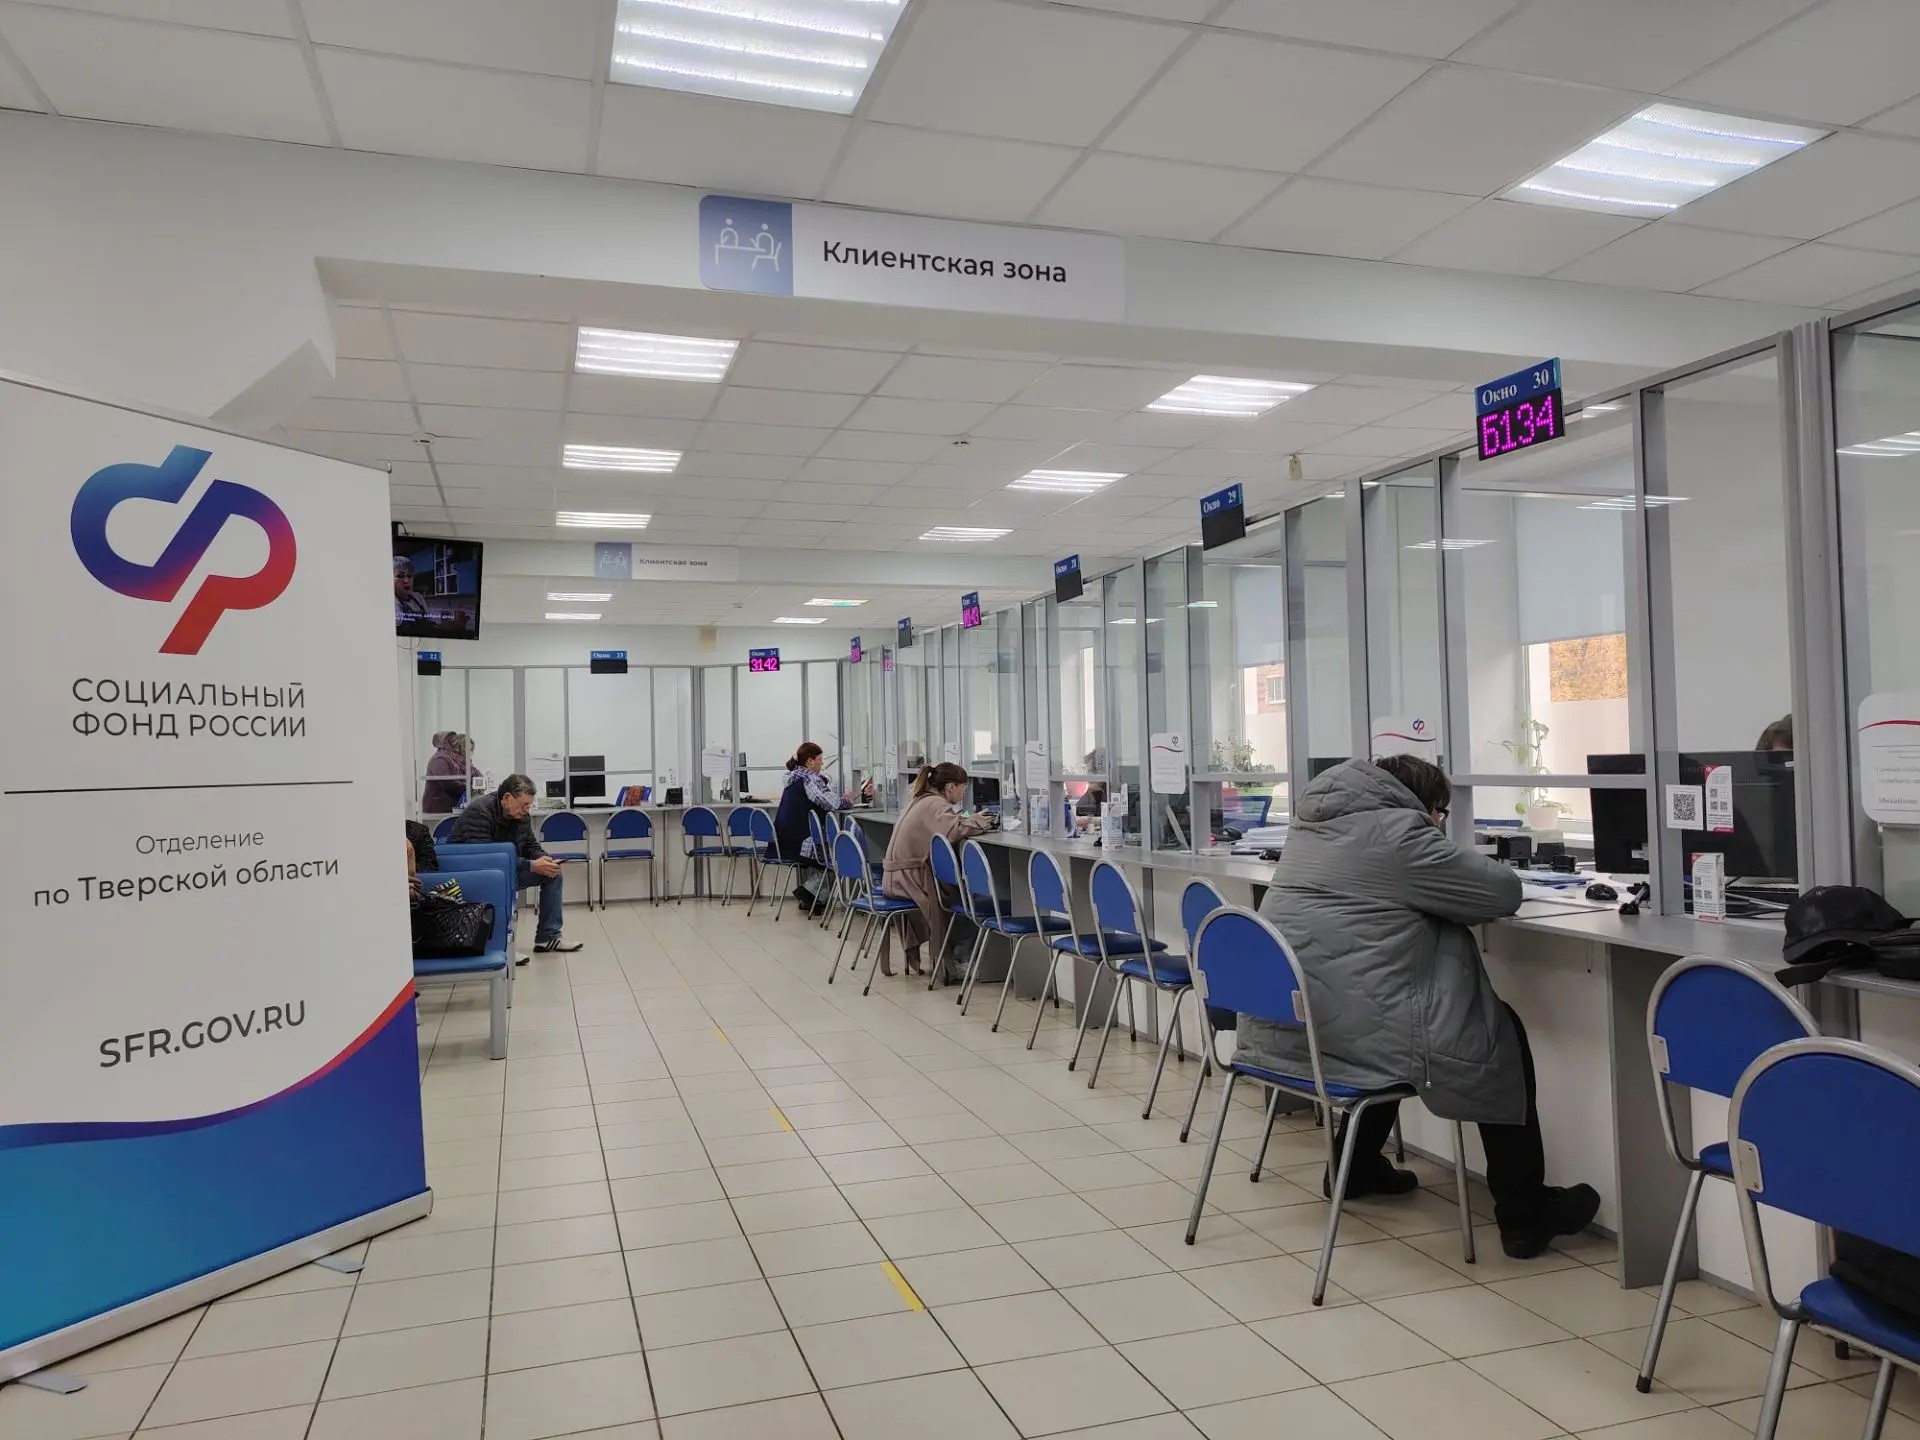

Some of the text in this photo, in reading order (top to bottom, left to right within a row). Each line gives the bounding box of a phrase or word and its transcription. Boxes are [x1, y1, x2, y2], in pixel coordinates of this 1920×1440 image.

[822, 240, 1067, 283] Клиентская зона
[1482, 368, 1549, 406] Окно 30
[1227, 490, 1237, 504] 29
[72, 678, 305, 708] СОЦИАЛЬНЫЙ
[72, 711, 306, 739] ФОНД РОССИИ
[136, 831, 265, 855] Отделение
[33, 858, 339, 907] по Тверской области
[99, 1000, 306, 1068] SFR.GOV.RU
